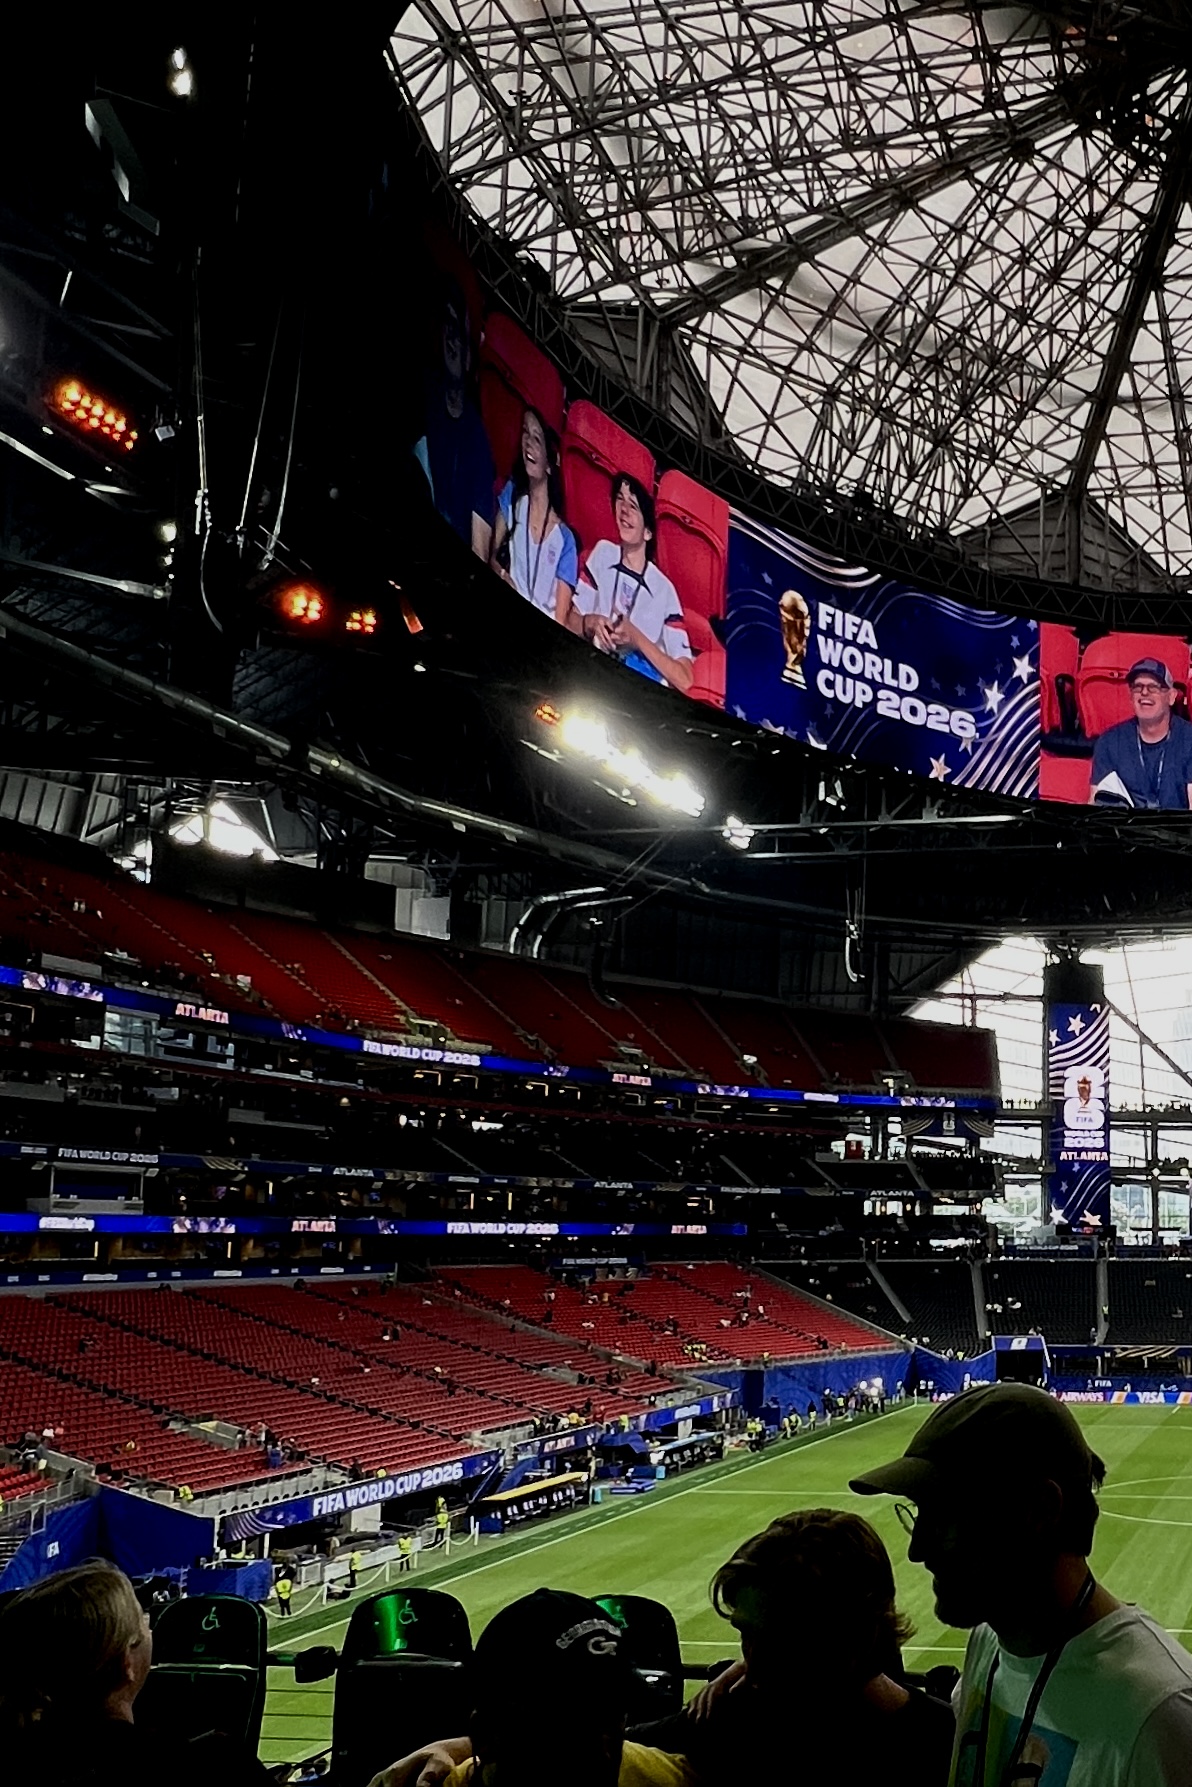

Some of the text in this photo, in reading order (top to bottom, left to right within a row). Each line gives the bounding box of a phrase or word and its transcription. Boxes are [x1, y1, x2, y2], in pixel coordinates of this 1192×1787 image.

[817, 602, 878, 649] FIFA
[816, 634, 919, 692] WORLD
[816, 670, 977, 739] CUP 2026
[58, 1147, 78, 1159] FIFA
[79, 1149, 111, 1161] WORLD
[111, 1151, 129, 1162] CUP
[1060, 1151, 1109, 1161] ATLANTA
[333, 1166, 375, 1178] ATLANTA
[594, 1181, 634, 1189] ATLANTA
[870, 1190, 915, 1198] ATLANTA
[1094, 1380, 1113, 1388] FIFA
[1137, 1392, 1165, 1403] VISA
[313, 1462, 464, 1517] FIFA WORLD CUP 2026
